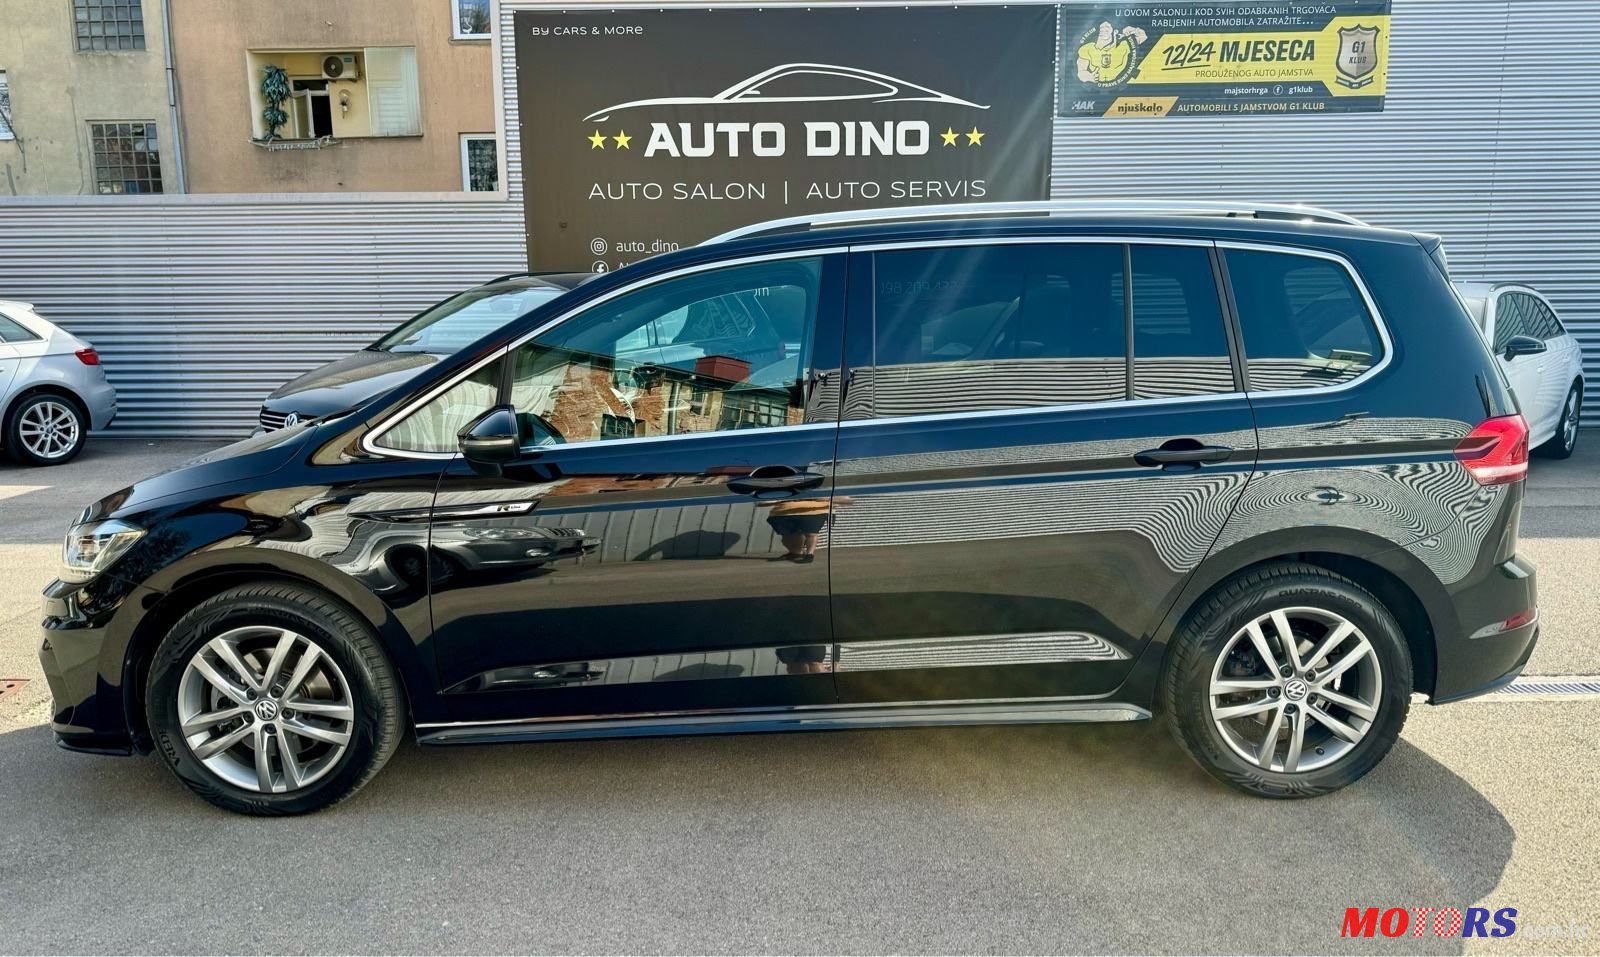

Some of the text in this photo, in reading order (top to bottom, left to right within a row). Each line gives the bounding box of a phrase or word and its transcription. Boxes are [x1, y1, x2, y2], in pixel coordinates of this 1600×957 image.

[1115, 9, 1121, 17] U
[1124, 8, 1150, 17] OVOM
[1153, 8, 1187, 17] SALONU
[1195, 7, 1213, 16] KOD
[1216, 7, 1235, 16] SVIH
[1237, 7, 1289, 16] ODABRANIH
[1291, 5, 1337, 15] TRGOVACA
[1151, 19, 1196, 29] RABLJENIH
[1198, 18, 1254, 27] AUTOMOBILA
[553, 26, 587, 36] CARS
[591, 26, 600, 35] &
[1161, 39, 1315, 67] 12/24 MJESECA
[1351, 41, 1366, 54] G1
[1195, 68, 1314, 78] PRODUŽENOG AUTO JAMSTVA
[1224, 86, 1314, 96] majstorhrga g1klub
[1072, 100, 1096, 111] HAK
[1117, 102, 1163, 116] njuškalo
[1177, 102, 1325, 113] AUTOMOBILI S JAMSTVOM G1 KLUB
[643, 120, 930, 158] AUTO DINO
[588, 182, 663, 200] AUTO
[673, 182, 766, 200] SALON
[806, 181, 881, 199] AUTO
[891, 179, 987, 199] SERVIS
